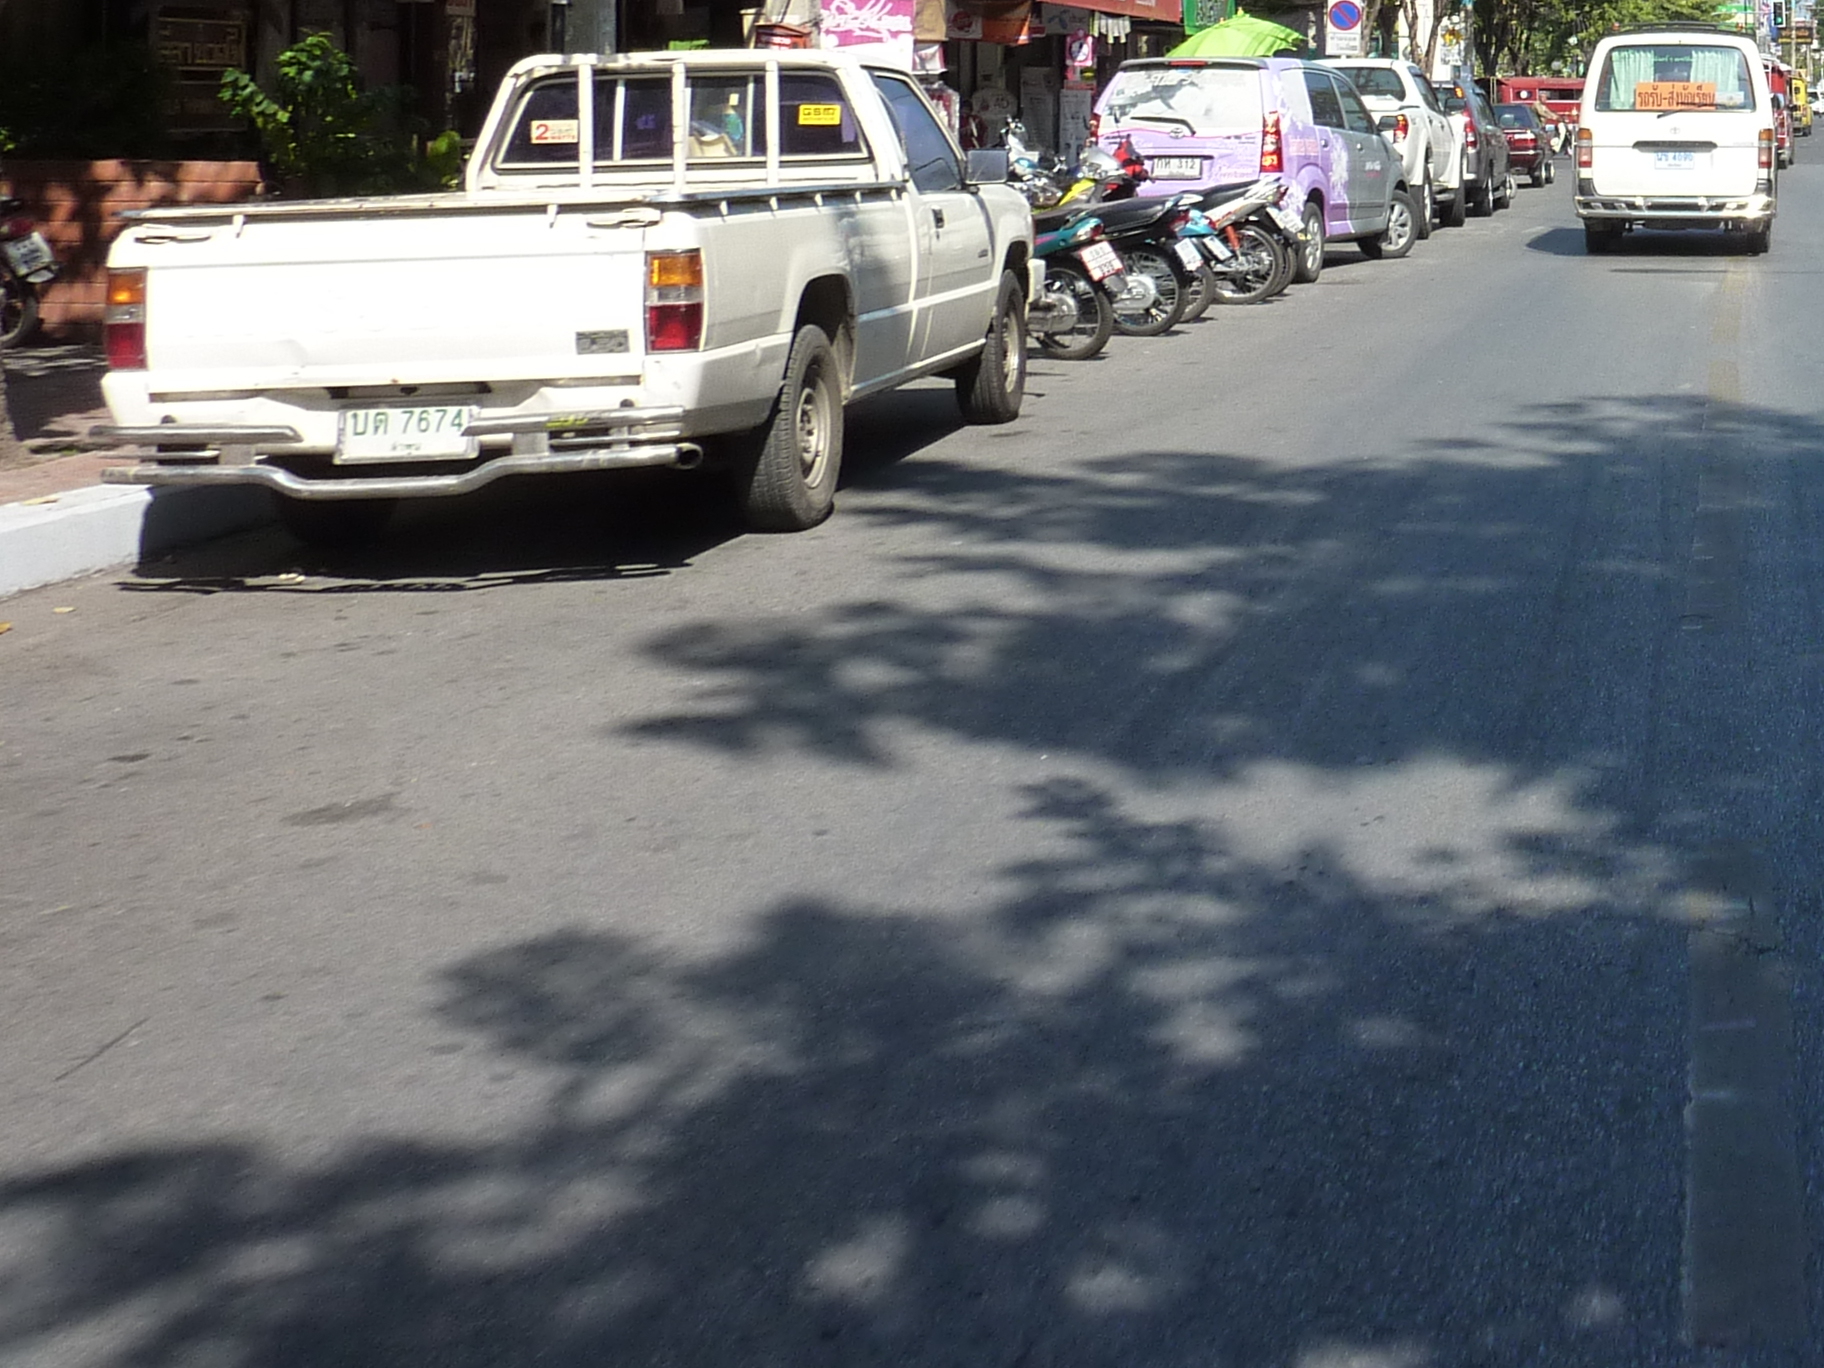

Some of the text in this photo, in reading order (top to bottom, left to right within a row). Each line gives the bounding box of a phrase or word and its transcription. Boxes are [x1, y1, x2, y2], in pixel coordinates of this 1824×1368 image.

[536, 123, 548, 140] 2
[1177, 158, 1196, 169] 312
[401, 409, 463, 434] 7674
